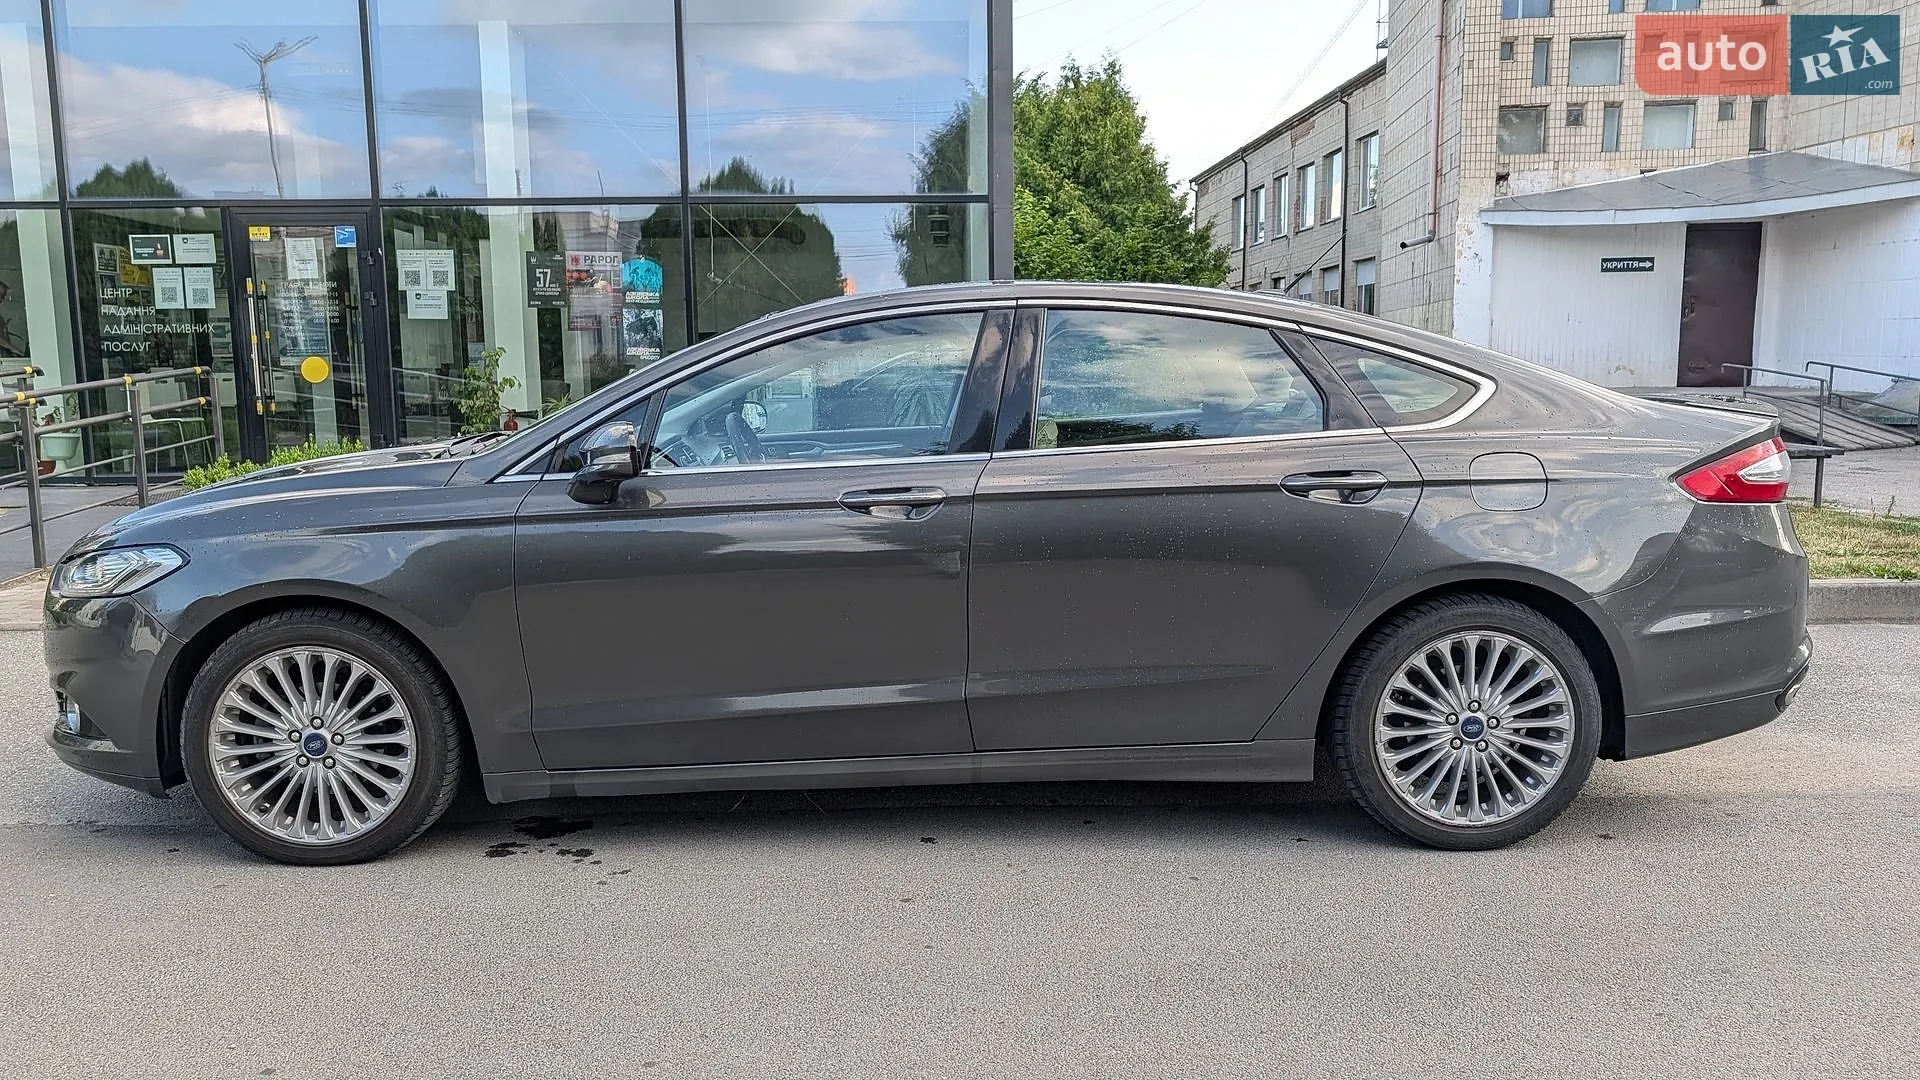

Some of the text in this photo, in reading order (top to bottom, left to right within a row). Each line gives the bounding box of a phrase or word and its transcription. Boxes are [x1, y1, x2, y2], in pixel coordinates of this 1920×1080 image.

[583, 255, 619, 267] РАРОГ
[1602, 260, 1639, 269] УКРИТТЯ
[535, 268, 551, 289] 57
[99, 287, 133, 299] ЦЕНТР
[101, 305, 156, 316] НАДАННЯ
[103, 323, 215, 335] АДМІНІСТРАТИВНИХ
[104, 341, 152, 352] ПОСЛУГ
